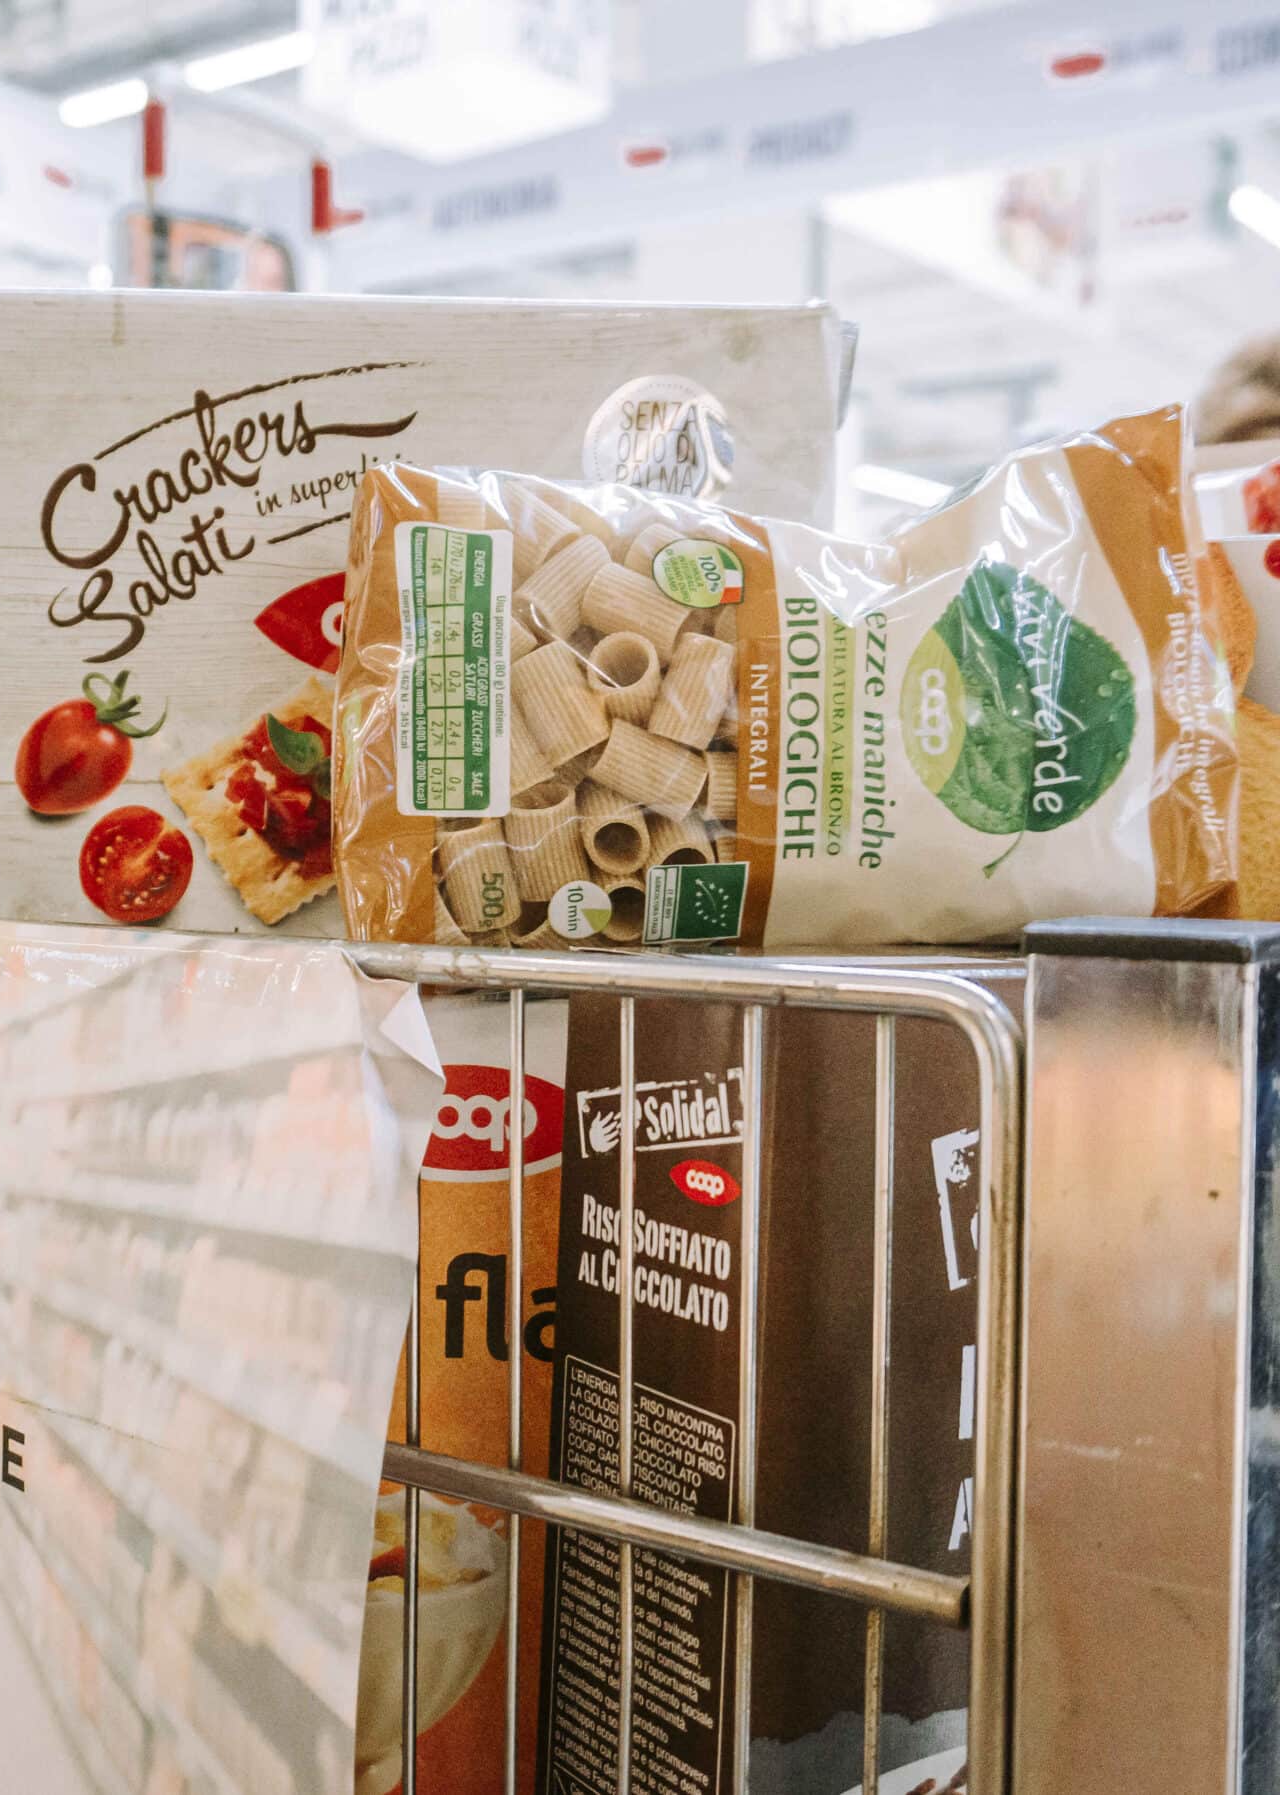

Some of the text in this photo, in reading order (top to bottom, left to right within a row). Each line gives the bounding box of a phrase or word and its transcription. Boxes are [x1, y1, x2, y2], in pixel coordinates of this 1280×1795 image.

[621, 400, 698, 432] SENZA
[676, 433, 698, 465] DI
[40, 389, 417, 569] Crackers
[256, 454, 367, 517] in super
[48, 506, 255, 663] Salati
[471, 549, 486, 648] ENERGIA GRASSI
[495, 595, 507, 613] Una
[698, 556, 721, 592] 100%
[494, 615, 506, 657] porzione
[495, 660, 507, 677] (80
[465, 662, 476, 701] SATURI
[914, 668, 952, 756] coop
[471, 709, 483, 798] ZUCCHERI SALE
[748, 663, 769, 792] INTEGRALI
[782, 597, 821, 860] BIOLOGICHE
[826, 614, 847, 856] AFILATURA AL BRONZO
[858, 611, 896, 869] ezze maniche
[567, 886, 584, 932] 10 min
[431, 1094, 538, 1153] oop
[644, 1082, 731, 1143] Solidal
[685, 1168, 725, 1199] coop
[581, 1193, 732, 1282] RIS SOFFIATO
[435, 1252, 556, 1363] fla
[578, 1249, 730, 1333] AL CICCOLATO
[568, 1416, 614, 1448] SOFFIATO
[570, 1384, 581, 1399] LA
[583, 1390, 619, 1416] GOLOSI
[571, 1367, 724, 1444] L'ENERGIA RISO INCONTRA
[567, 1432, 596, 1456] COOP
[682, 1486, 697, 1505] LA
[569, 1400, 576, 1414] A
[577, 1404, 619, 1434] COLAZIO
[639, 1431, 682, 1462] CHICCHI
[684, 1451, 696, 1468] DI
[697, 1455, 726, 1481] RISO
[566, 1448, 602, 1476] CARICA
[632, 1480, 695, 1517] FFRONTARE
